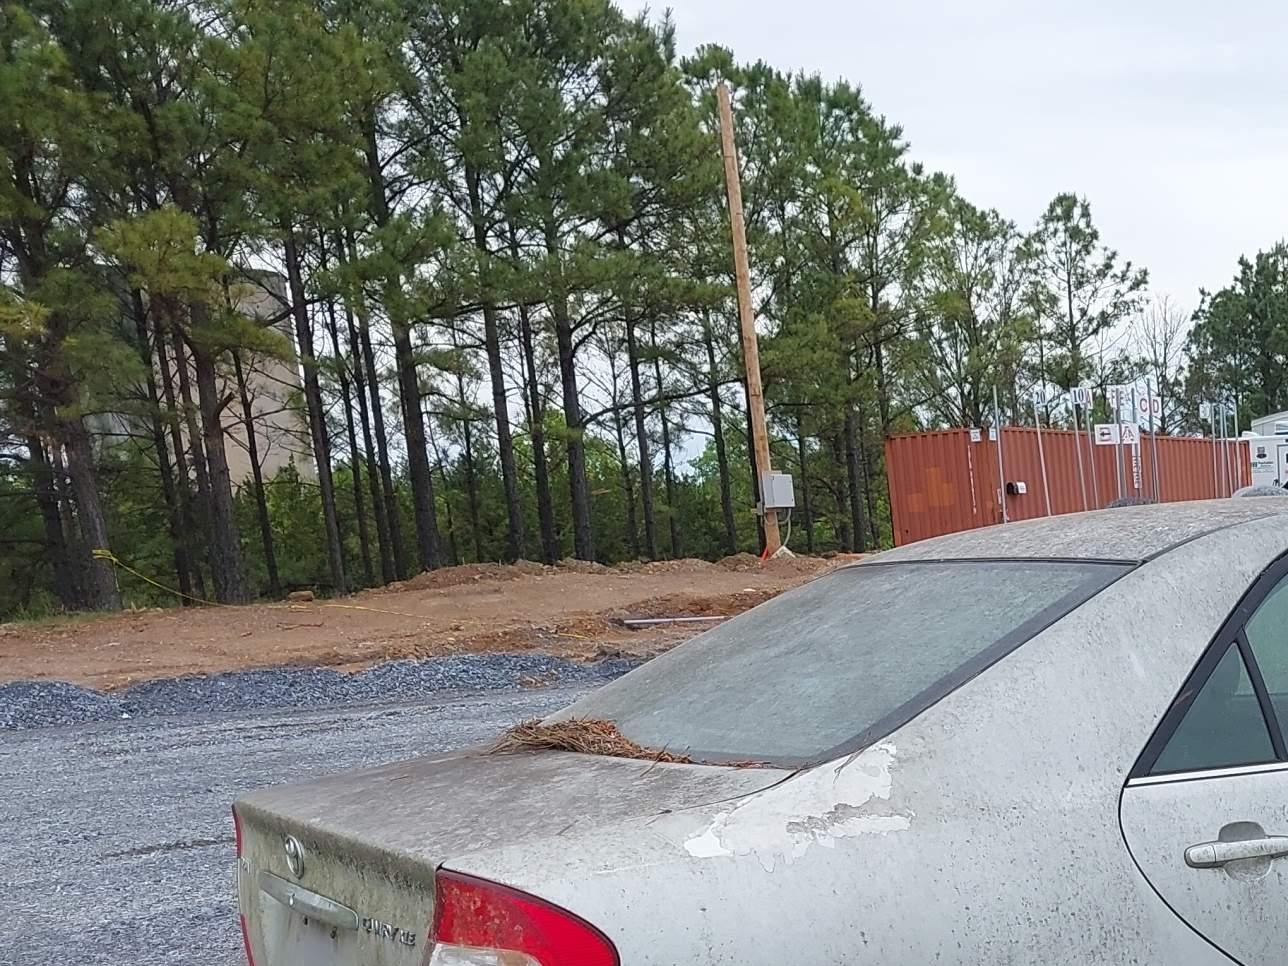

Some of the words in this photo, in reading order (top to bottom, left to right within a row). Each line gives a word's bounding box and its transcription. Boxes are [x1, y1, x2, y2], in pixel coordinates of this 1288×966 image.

[1035, 390, 1046, 405] 20
[1074, 388, 1084, 403] 10
[1139, 397, 1148, 412] C
[1152, 398, 1160, 413] D
